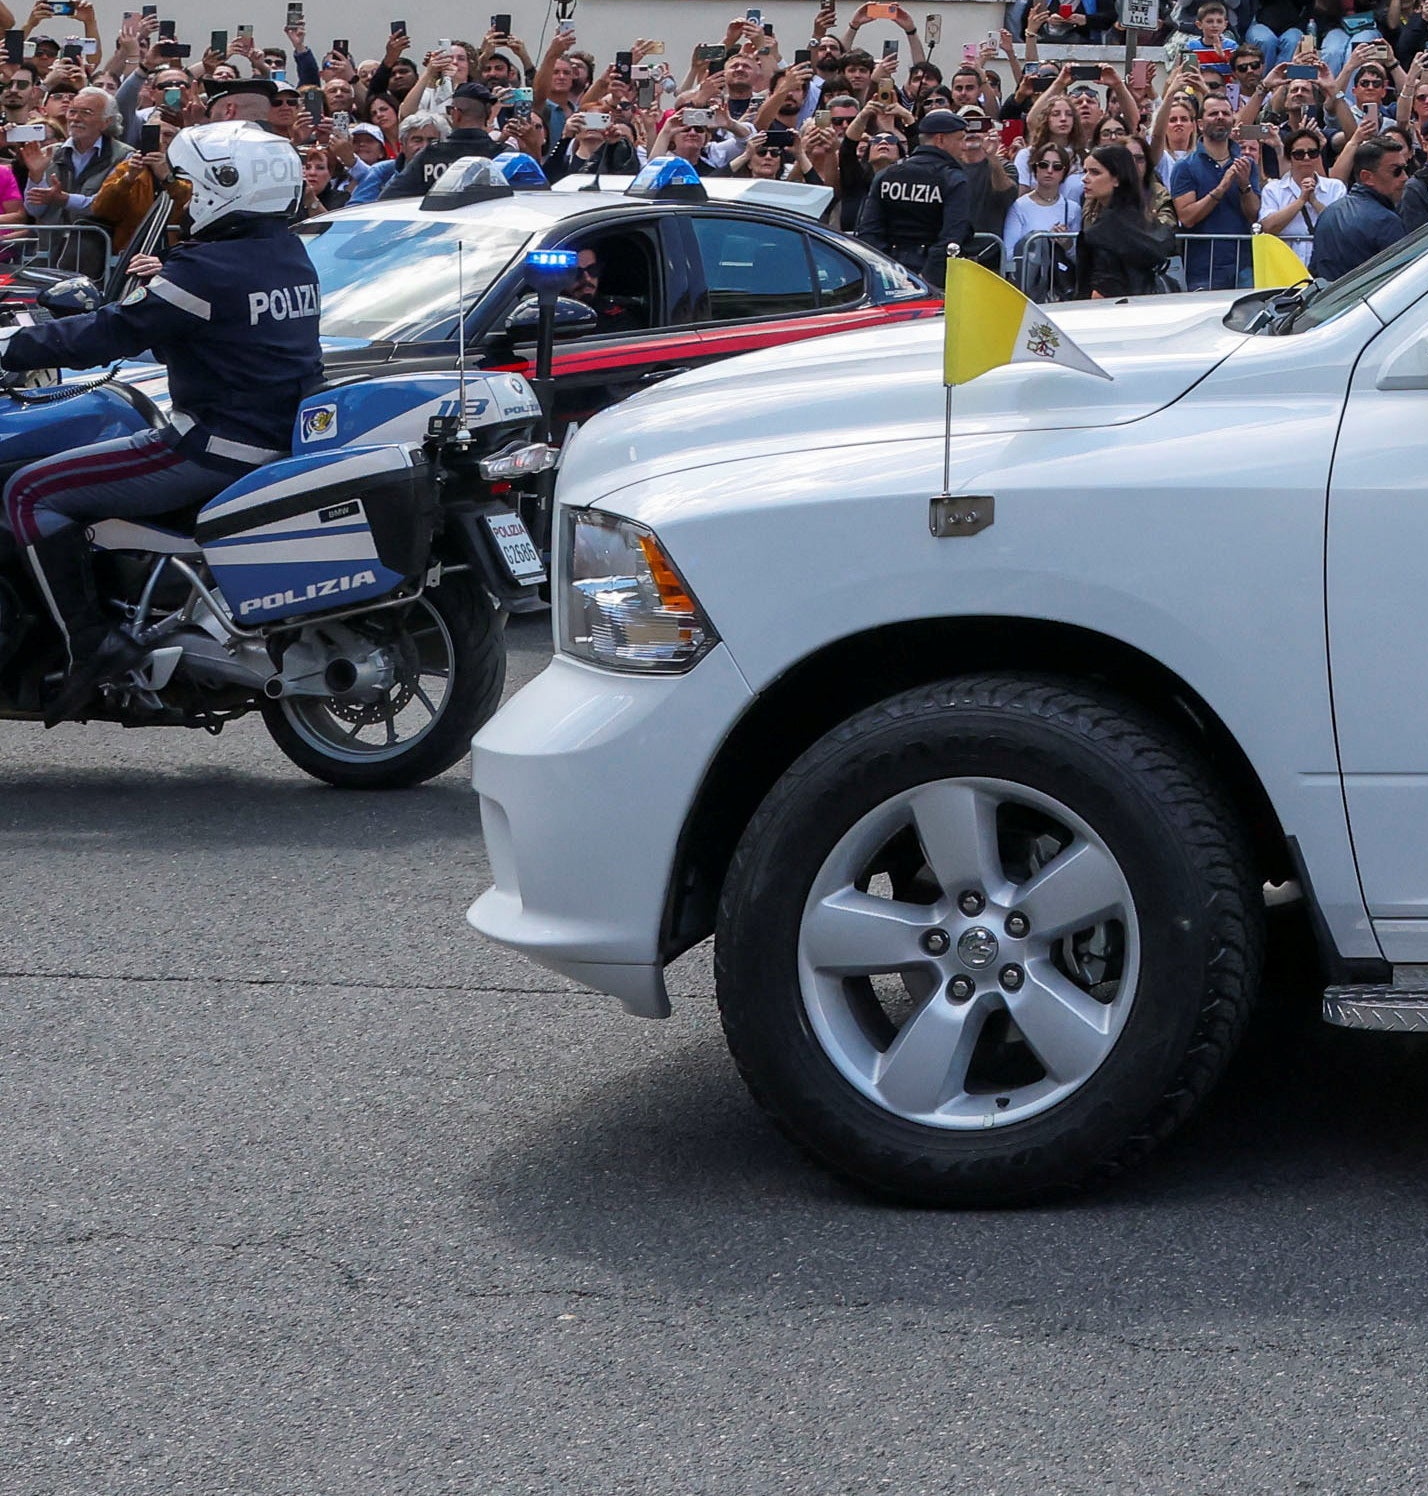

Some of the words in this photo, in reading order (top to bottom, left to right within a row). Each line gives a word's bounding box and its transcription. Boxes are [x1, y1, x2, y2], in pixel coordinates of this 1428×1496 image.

[880, 181, 943, 204] POLIZIA
[437, 398, 491, 418] 113
[328, 506, 351, 518] BMW
[493, 523, 528, 539] POLIZIA
[239, 569, 377, 616] POLIZIA
